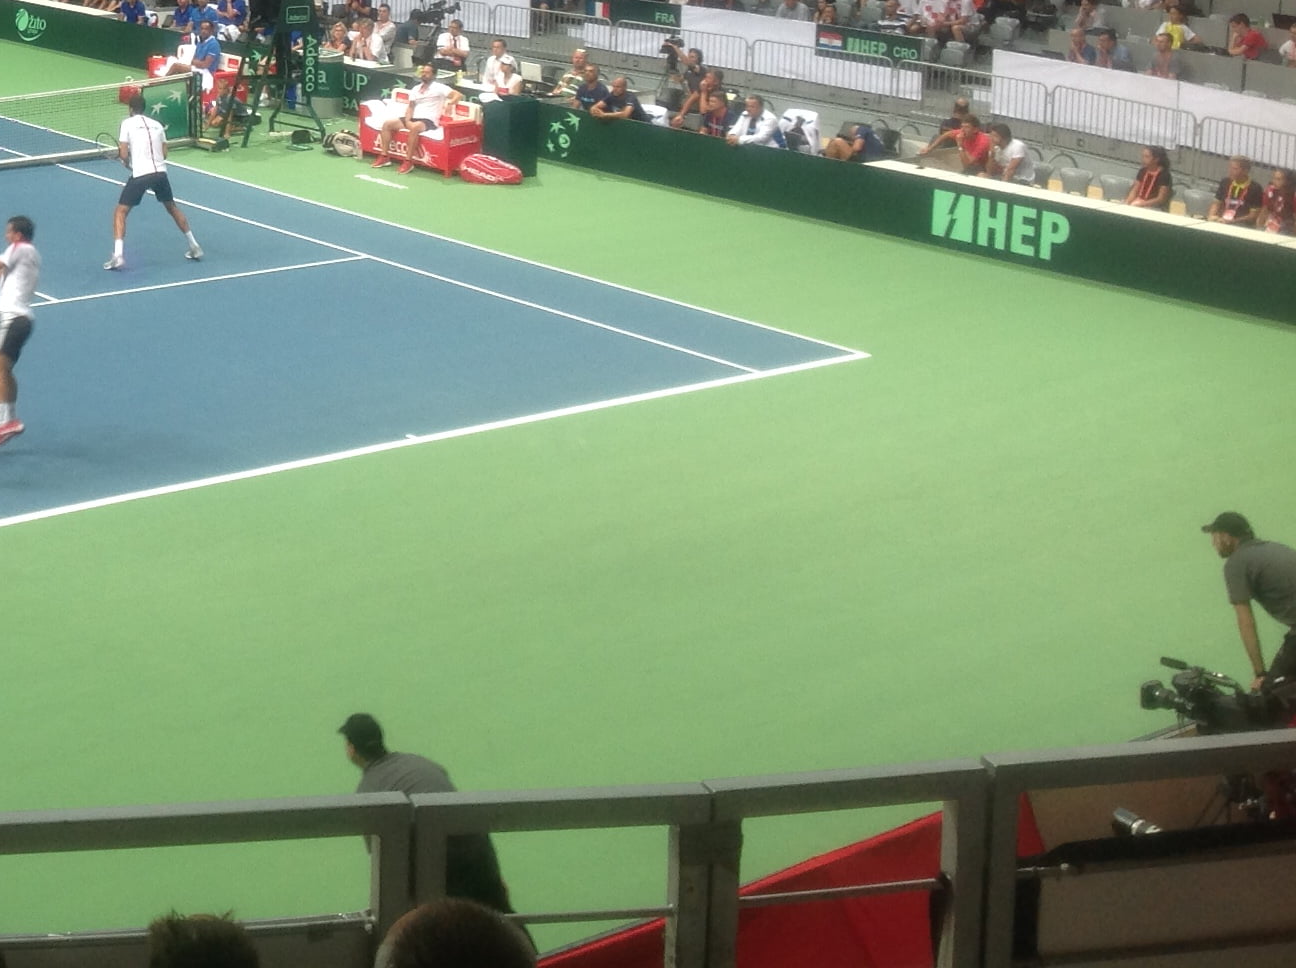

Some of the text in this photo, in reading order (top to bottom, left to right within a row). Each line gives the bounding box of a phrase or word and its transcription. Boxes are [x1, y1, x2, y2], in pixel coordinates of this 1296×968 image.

[305, 34, 318, 92] Adecco
[892, 45, 918, 60] CRO
[343, 70, 369, 92] UP
[976, 197, 1070, 261] HEP
